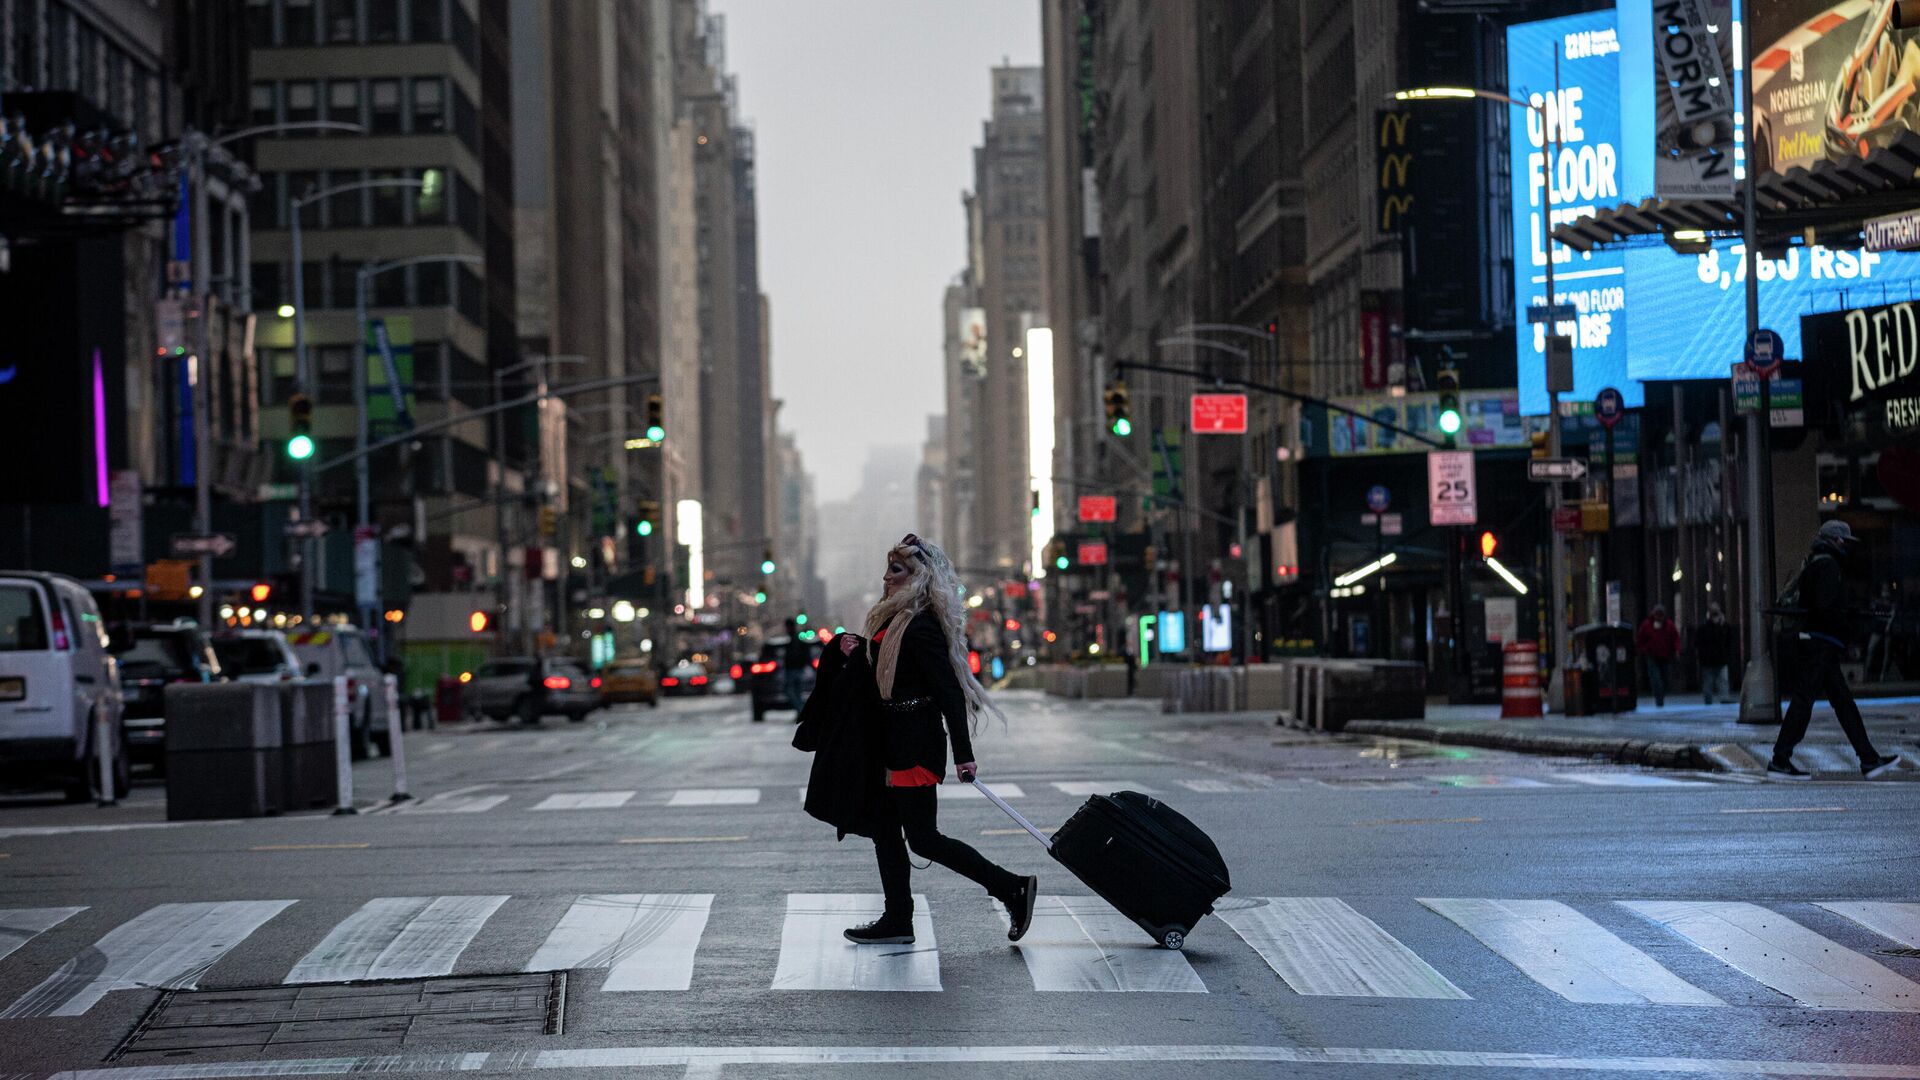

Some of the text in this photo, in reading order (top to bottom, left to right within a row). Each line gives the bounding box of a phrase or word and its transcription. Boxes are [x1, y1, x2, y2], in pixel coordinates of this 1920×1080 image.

[1770, 79, 1827, 113] NORWEGIAN
[1527, 87, 1584, 148] ONE
[1528, 143, 1618, 207] FLOOR
[1866, 215, 1920, 250] OUTFRONT
[1811, 245, 1881, 279] RSF
[1591, 287, 1624, 313] FLOOR
[1579, 313, 1611, 349] RSF
[1845, 303, 1917, 402] RED
[1886, 396, 1920, 429] FRESH
[1438, 480, 1469, 501] 25
